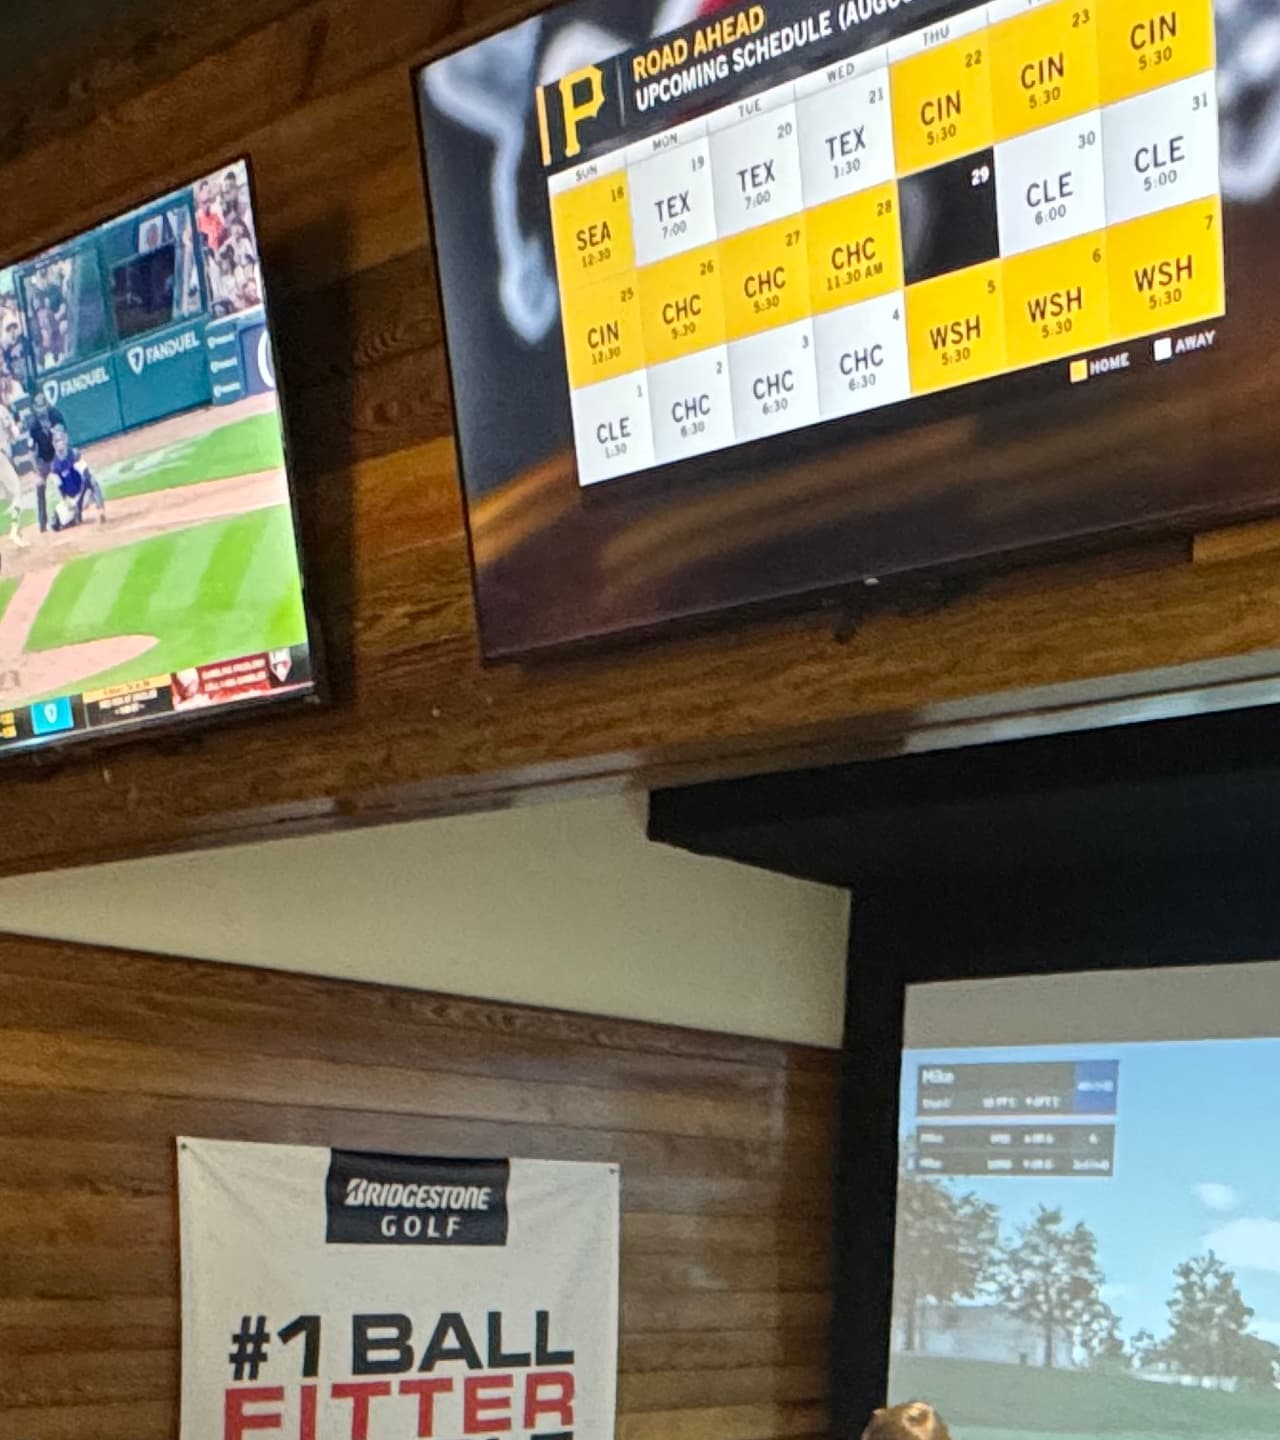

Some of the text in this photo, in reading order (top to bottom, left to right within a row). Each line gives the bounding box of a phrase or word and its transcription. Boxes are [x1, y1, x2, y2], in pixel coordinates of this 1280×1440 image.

[632, 5, 765, 83] ROAD AHEAD
[635, 53, 730, 112] UPCOMING
[732, 9, 832, 72] SCHEDULE
[691, 155, 705, 172] 19
[777, 122, 793, 140] 20
[869, 88, 884, 104] 21
[965, 50, 982, 68] 22
[1072, 9, 1090, 28] 23
[559, 64, 605, 158] P
[576, 24, 950, 182] SUN MON TUE WED THU
[576, 11, 1177, 251] SEA TEX TEX TEX CIN CIN CIN
[582, 46, 1173, 268] 12:30 7:00 7:00 1:30 5:30 5:30 5:30
[587, 135, 1185, 349] CIN CHC CHC CHC CLE CLE
[620, 92, 1208, 303] 25 26 27 28 29 30 31
[753, 295, 780, 314] 5:30
[826, 268, 862, 291] 11:30
[864, 262, 884, 279] AM
[1035, 204, 1067, 226] 6:00
[1143, 169, 1178, 192] 5:00
[146, 330, 200, 364] FANDUEL
[596, 254, 1193, 444] CLE CHC CHC CHC WSH WSH WSH
[636, 385, 643, 397] 1
[802, 335, 809, 349] 3
[892, 308, 900, 321] 4
[987, 280, 996, 294] 5
[1092, 248, 1102, 263] 6
[1204, 214, 1213, 231] 7
[762, 397, 788, 415] 6:30
[848, 373, 877, 392] 6:30
[941, 346, 971, 366] 5:30
[1041, 318, 1072, 339] 5:30
[1148, 288, 1182, 310] 5:30
[1175, 329, 1216, 354] AWAY
[60, 365, 111, 397] FANDUEL
[1089, 352, 1130, 376] HOME
[344, 1178, 491, 1210] BRIDGESTONE
[381, 1215, 461, 1238] GOLF
[229, 1309, 575, 1381] #1 BALL
